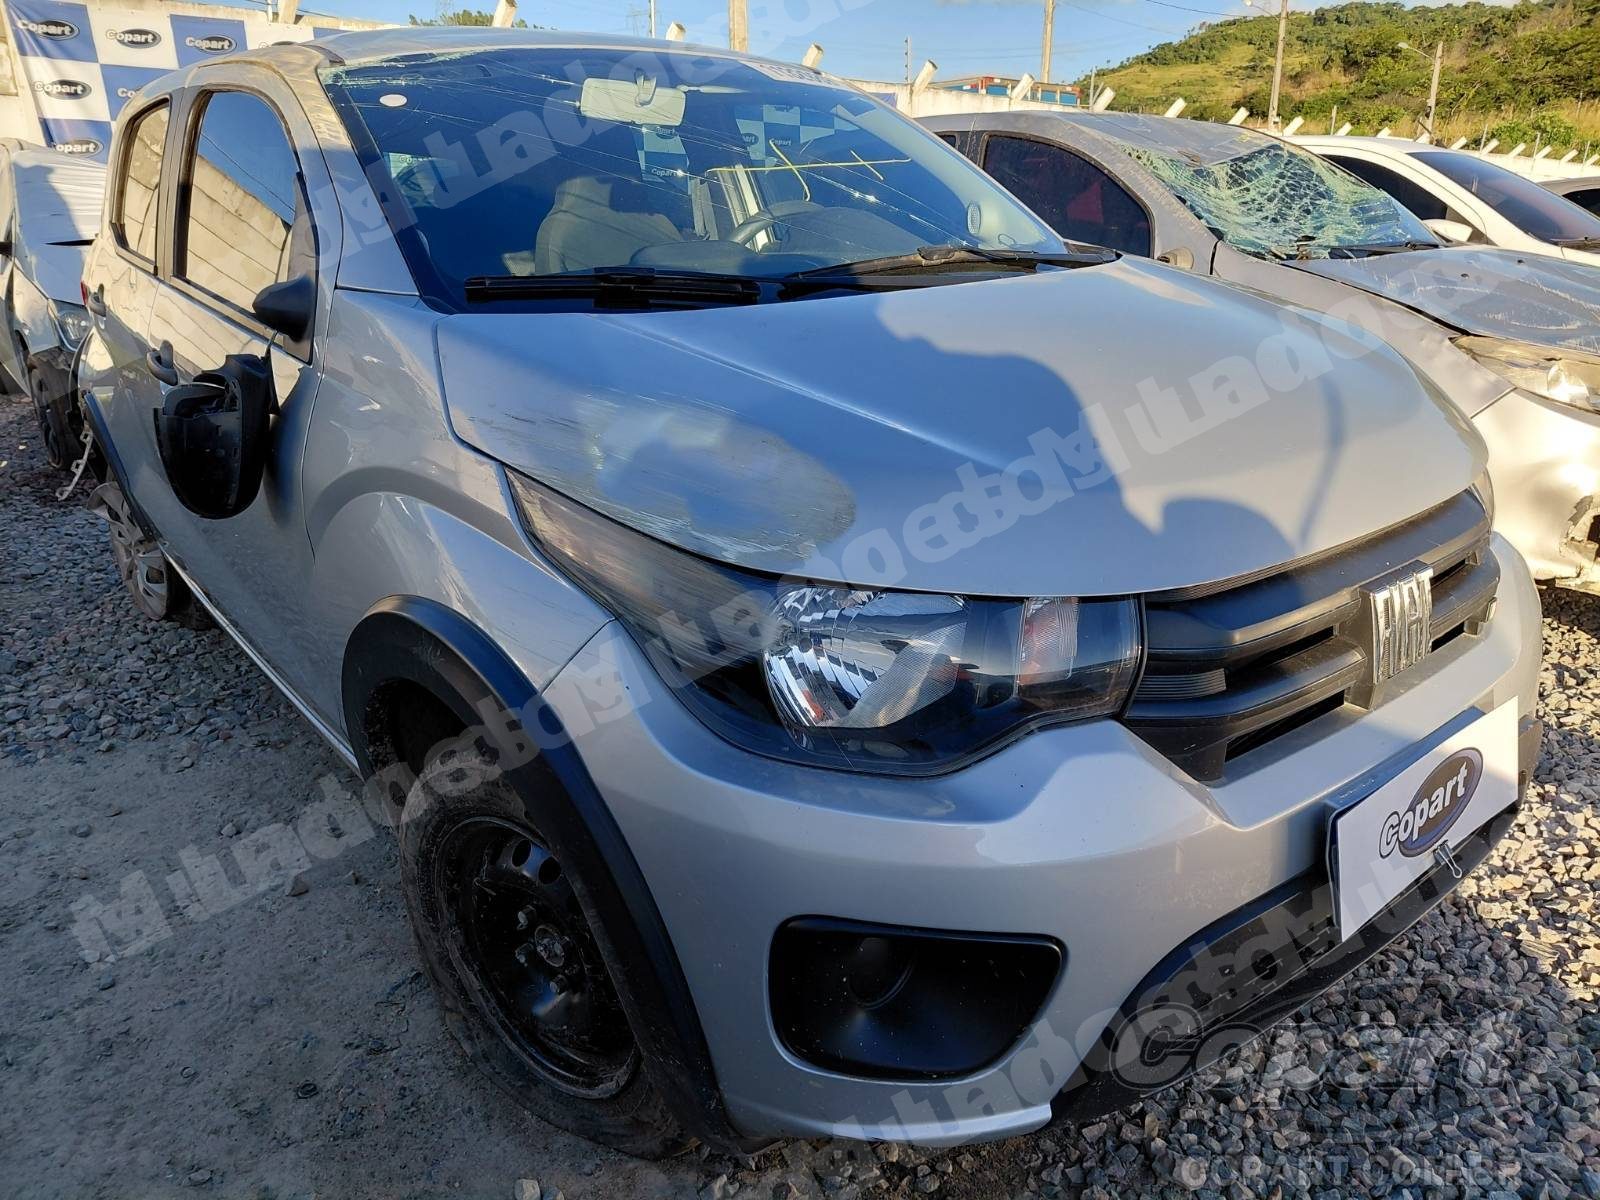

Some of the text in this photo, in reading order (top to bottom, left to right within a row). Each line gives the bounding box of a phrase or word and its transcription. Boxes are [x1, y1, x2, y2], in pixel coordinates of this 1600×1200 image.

[17, 20, 72, 37] Copart
[105, 29, 154, 43] Copart
[185, 36, 232, 50] Copart
[33, 80, 84, 96] Copart
[55, 142, 96, 153] opart
[1369, 566, 1434, 684] FIAT
[1379, 761, 1468, 859] Copart
